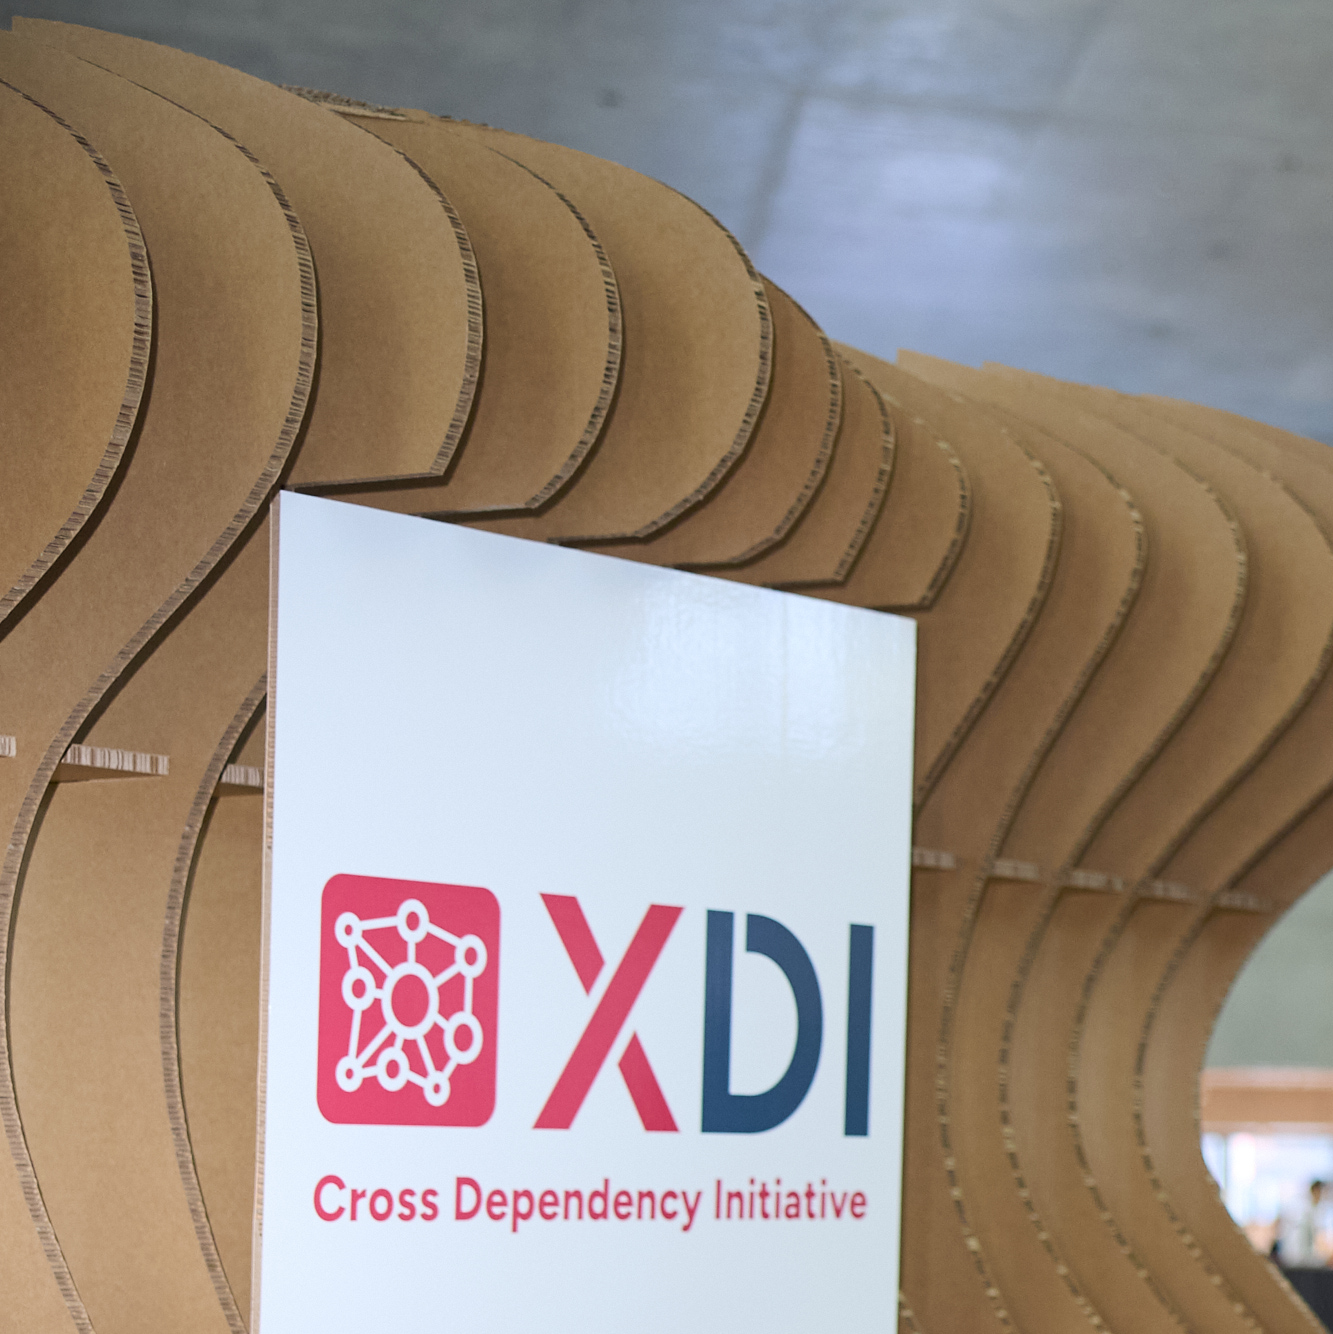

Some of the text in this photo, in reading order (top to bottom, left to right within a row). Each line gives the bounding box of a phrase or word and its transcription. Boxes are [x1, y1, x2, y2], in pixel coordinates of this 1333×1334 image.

[532, 892, 875, 1137] XDI
[313, 1174, 869, 1233] Cross Dependency Initiative
